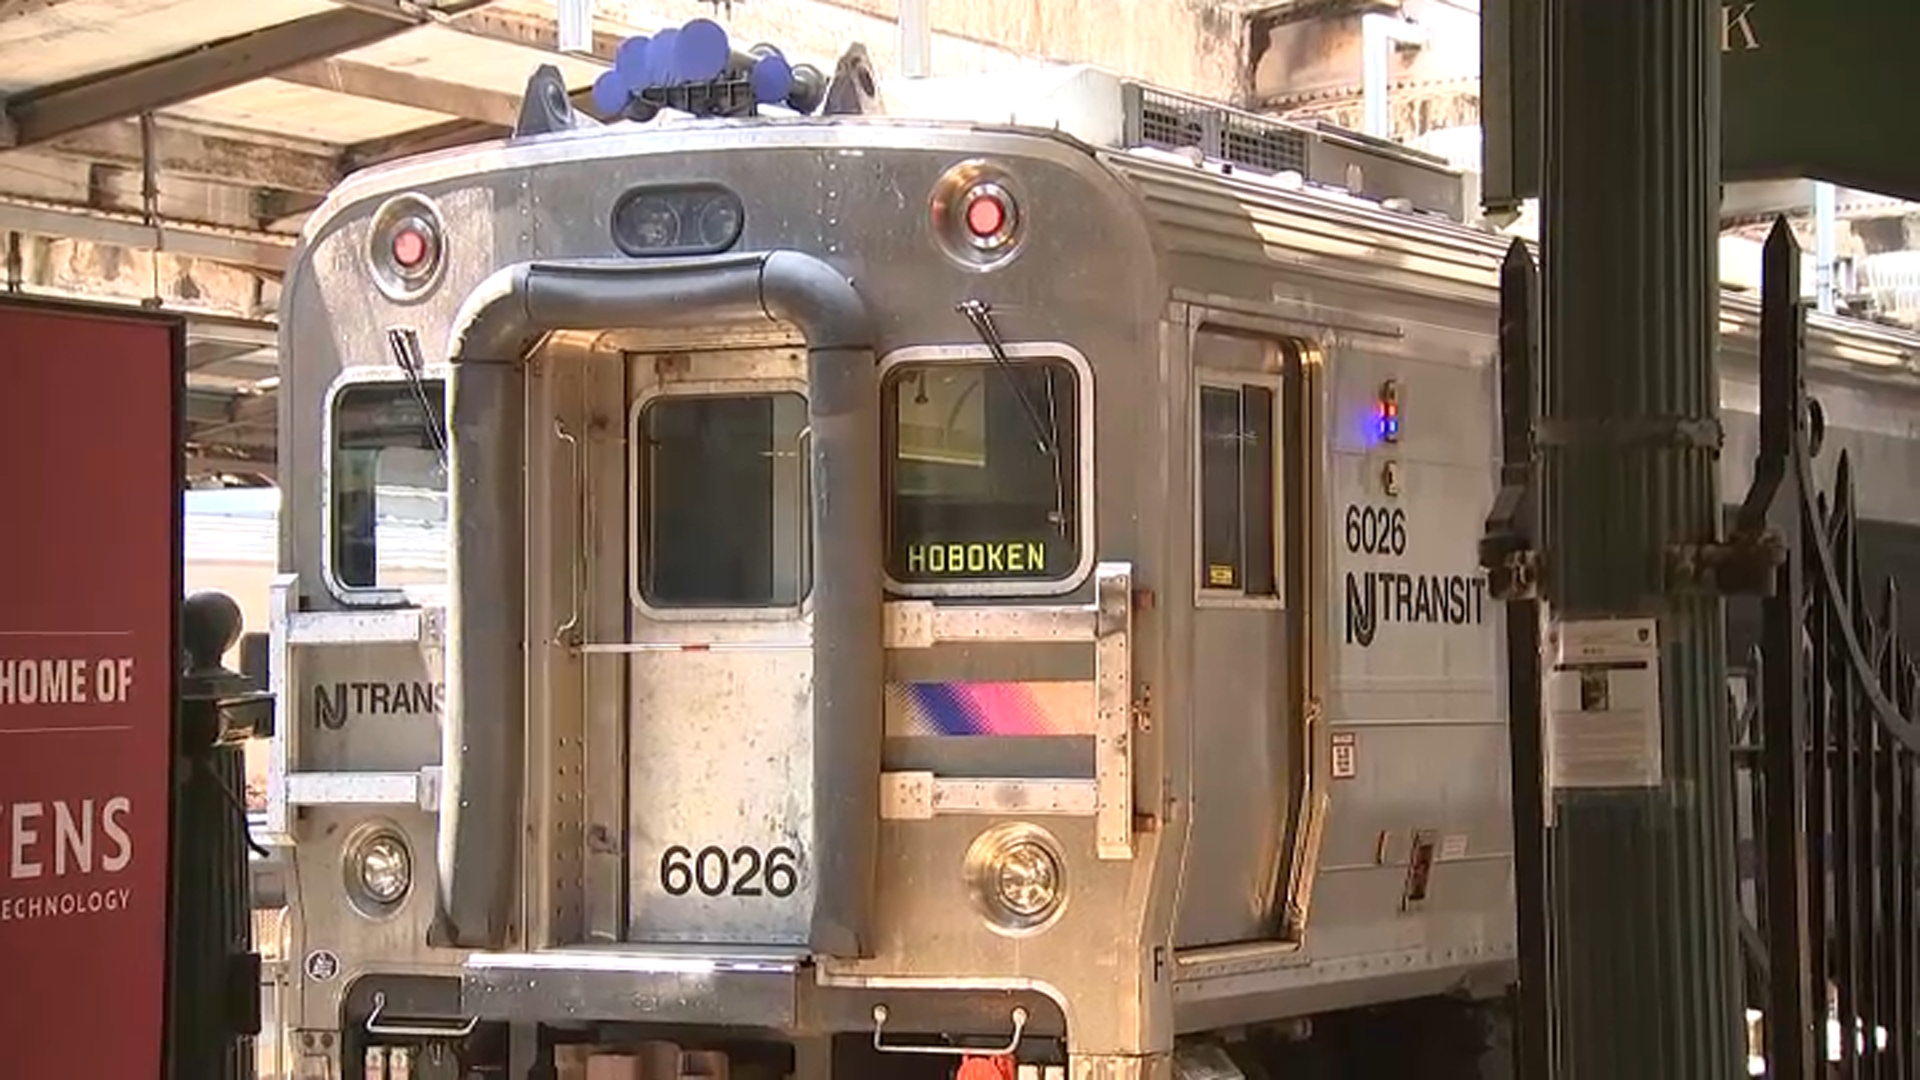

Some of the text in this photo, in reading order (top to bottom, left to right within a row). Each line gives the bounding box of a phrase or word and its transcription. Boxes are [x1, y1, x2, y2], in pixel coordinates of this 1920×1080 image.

[1346, 504, 1406, 556] 6026
[908, 543, 1044, 572] HOBOKEN
[1346, 572, 1486, 647] NJ TRANSIT
[0, 658, 133, 704] HOME OF
[314, 682, 348, 730] NJ
[0, 796, 132, 878] ENS
[660, 845, 798, 898] 6026
[1, 888, 130, 920] ECHNOLOGY
